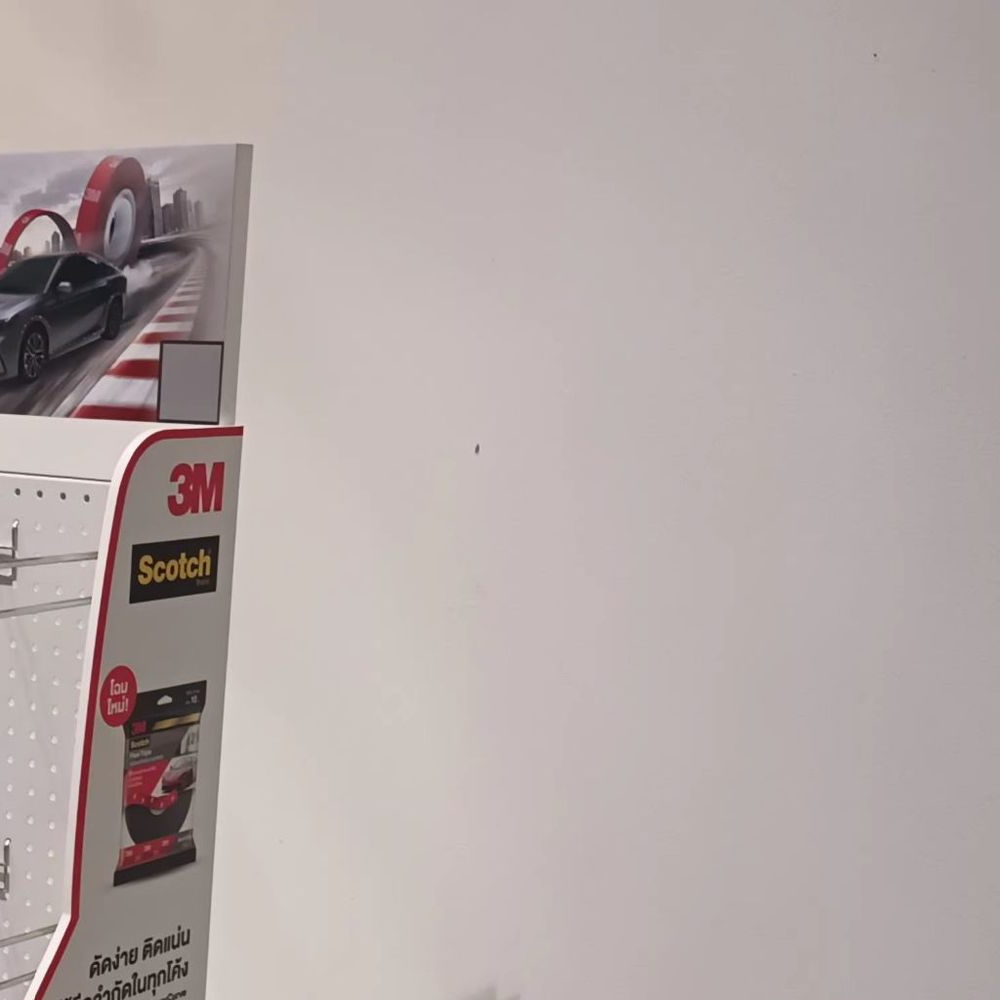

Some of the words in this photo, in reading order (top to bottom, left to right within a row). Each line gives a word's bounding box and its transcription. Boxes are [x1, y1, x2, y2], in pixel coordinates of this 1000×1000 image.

[167, 461, 225, 517] 3M
[137, 549, 212, 586] Scotch
[89, 945, 139, 979] ดัดง่าย
[142, 924, 191, 961] ติดแน่น
